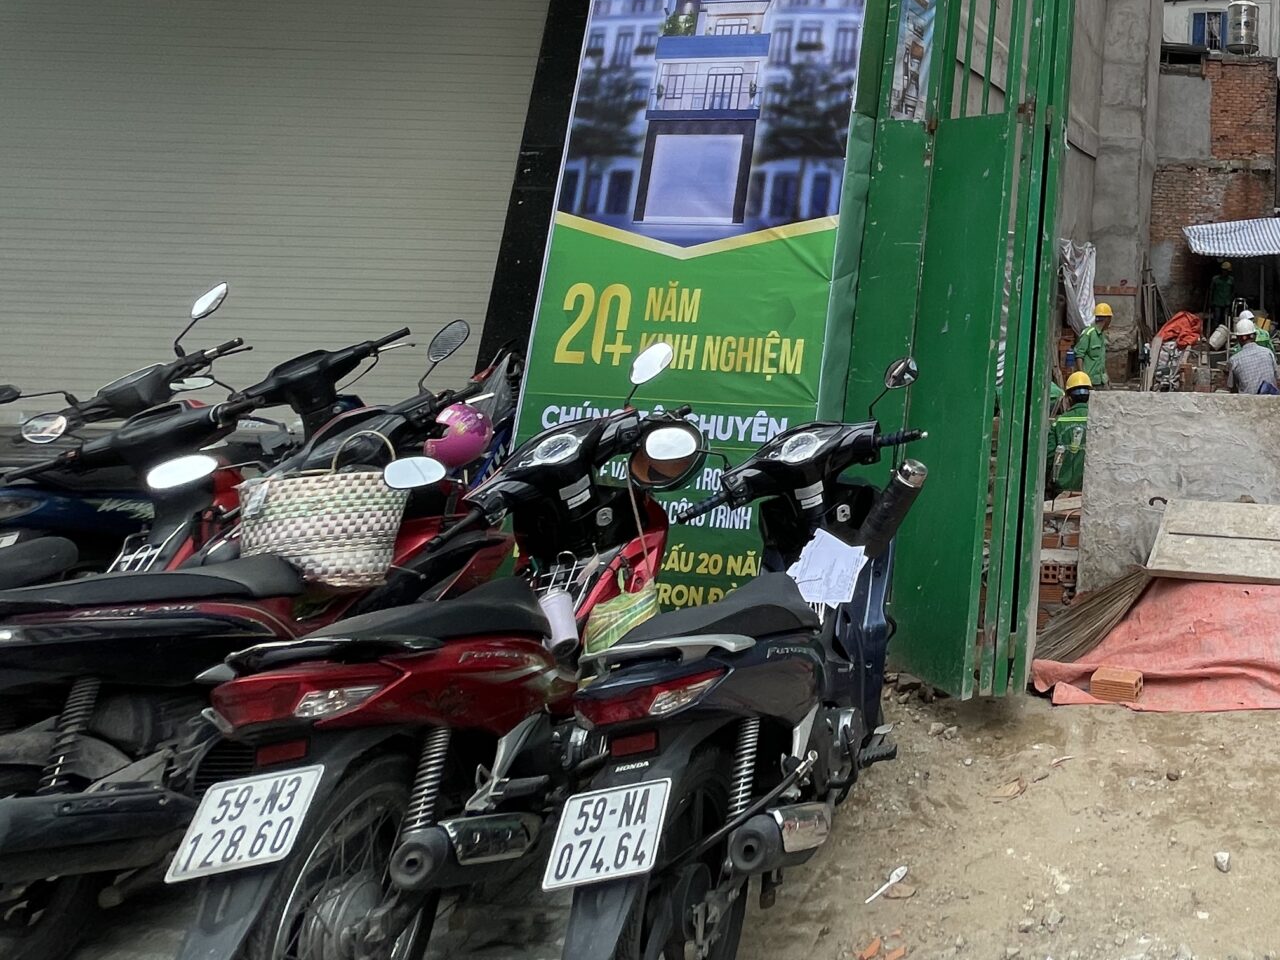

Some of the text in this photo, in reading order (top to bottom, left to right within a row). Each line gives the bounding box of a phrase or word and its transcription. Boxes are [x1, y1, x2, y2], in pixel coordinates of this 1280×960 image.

[644, 280, 702, 323] NĂM
[701, 330, 805, 381] NGHIỆM
[696, 552, 723, 575] 20
[615, 761, 649, 773] HONDA
[211, 776, 302, 824] 59-N3
[574, 788, 651, 836] 59-NA
[182, 816, 294, 872] 128.60
[553, 828, 647, 881] 074.64
